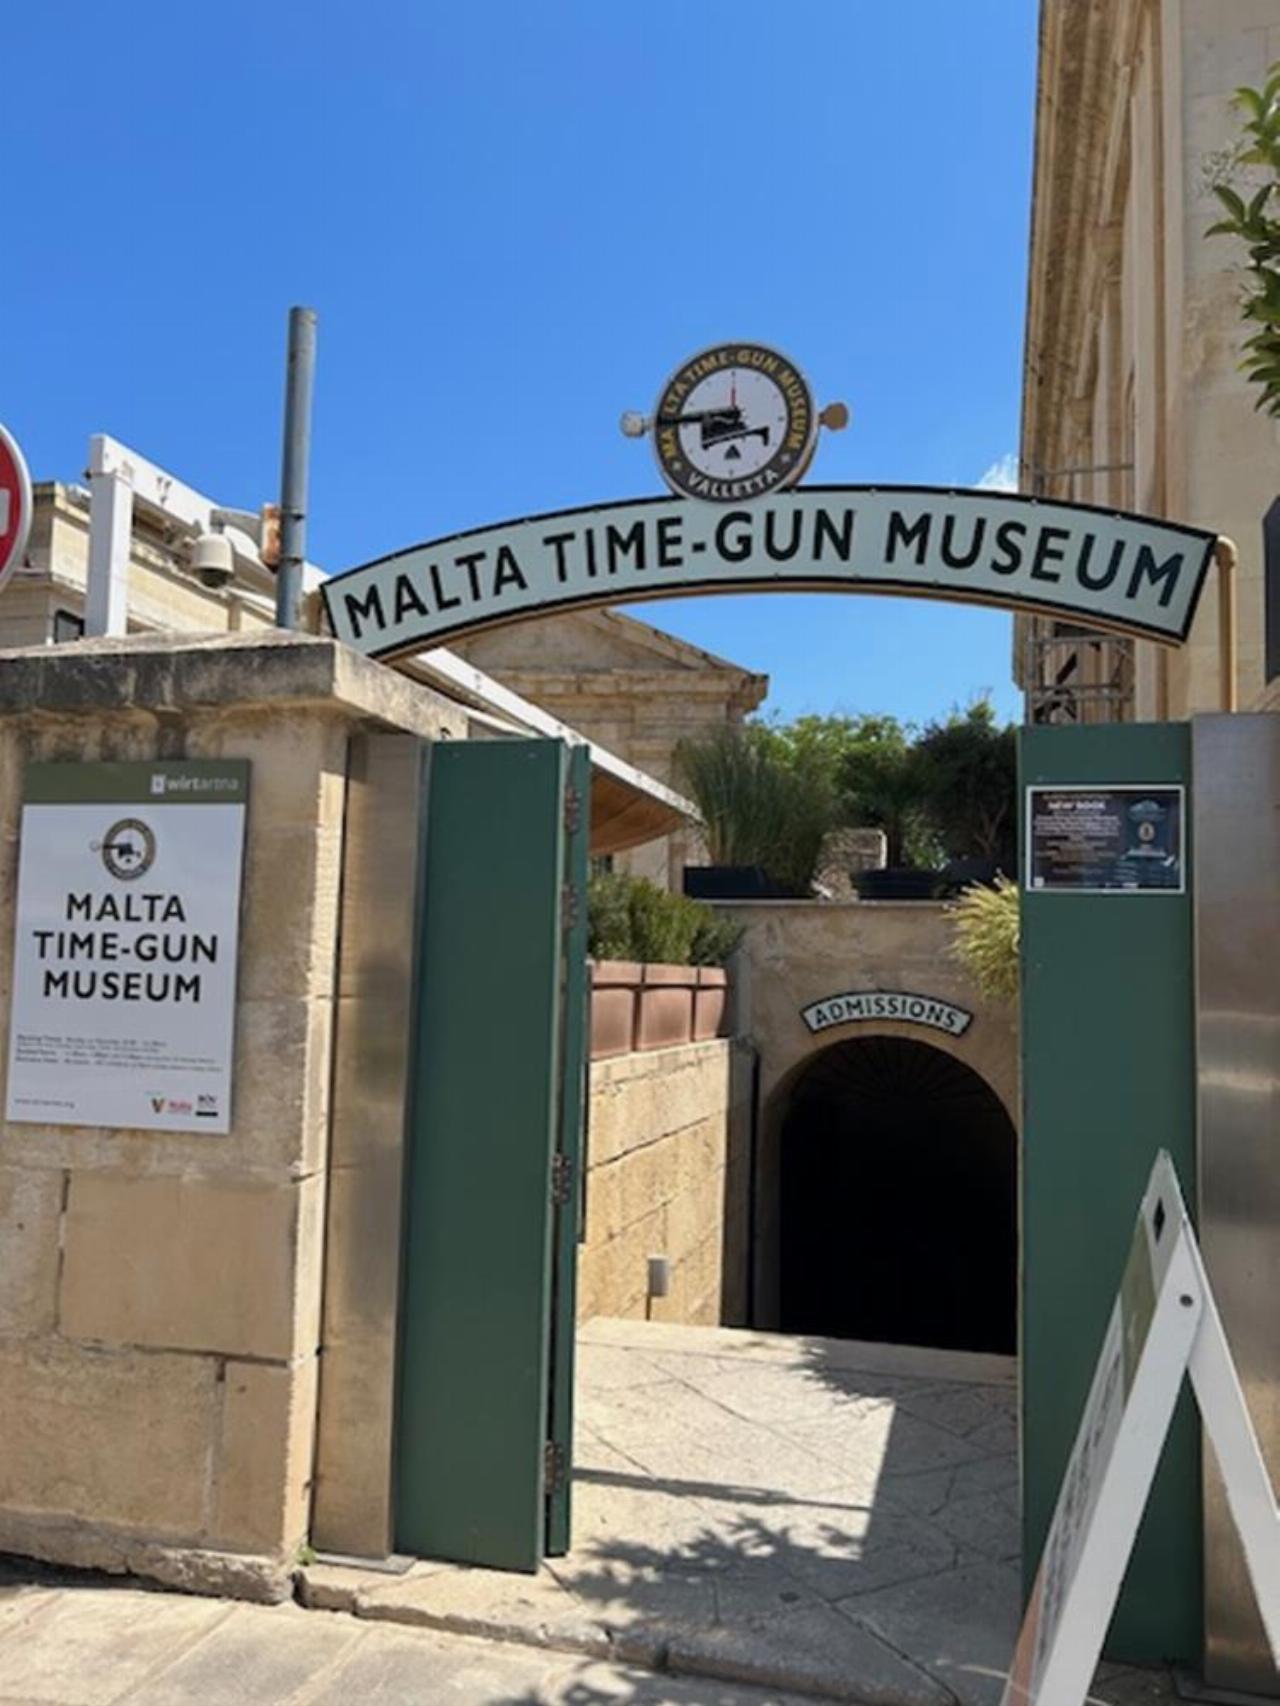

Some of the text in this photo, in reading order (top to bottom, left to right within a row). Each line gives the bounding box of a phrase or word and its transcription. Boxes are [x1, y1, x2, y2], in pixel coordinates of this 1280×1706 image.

[688, 350, 777, 384] TIME-GUN
[778, 369, 808, 449] MUSEUM
[687, 469, 780, 498] VALLETTA
[343, 509, 1184, 639] MALTA TIME-GUN MUSEUM
[66, 893, 186, 923] MALTA
[33, 931, 218, 963] TIME-GUN
[43, 970, 201, 1003] MUSEUM
[815, 996, 959, 1028] ADMISSIONS
